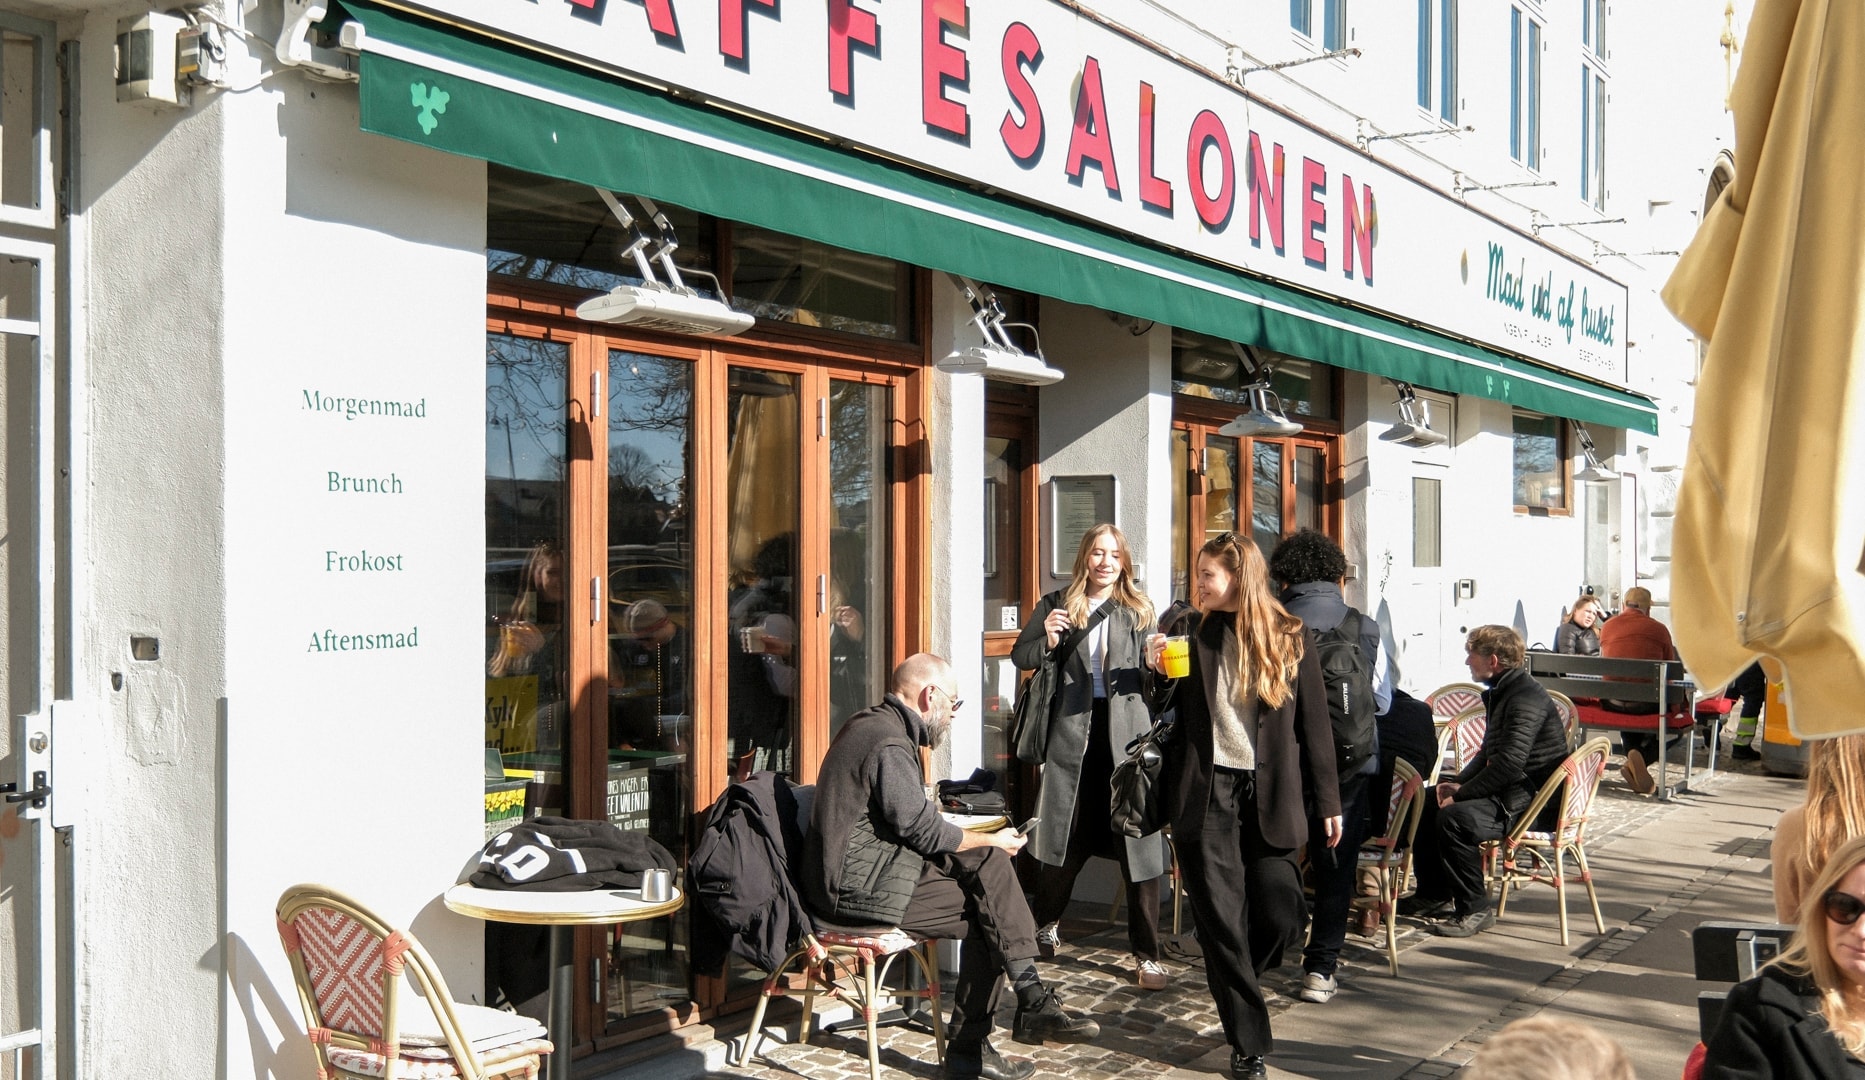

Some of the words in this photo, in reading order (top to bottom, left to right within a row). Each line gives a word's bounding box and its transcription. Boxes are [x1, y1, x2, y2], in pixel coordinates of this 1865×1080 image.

[1486, 240, 1525, 312] Mad
[1557, 279, 1574, 345] af
[1581, 286, 1614, 348] huset
[301, 389, 426, 421] Morgenmad
[327, 471, 403, 494] Brunch
[325, 549, 403, 572] Frokost
[307, 625, 419, 653] Aftensmad
